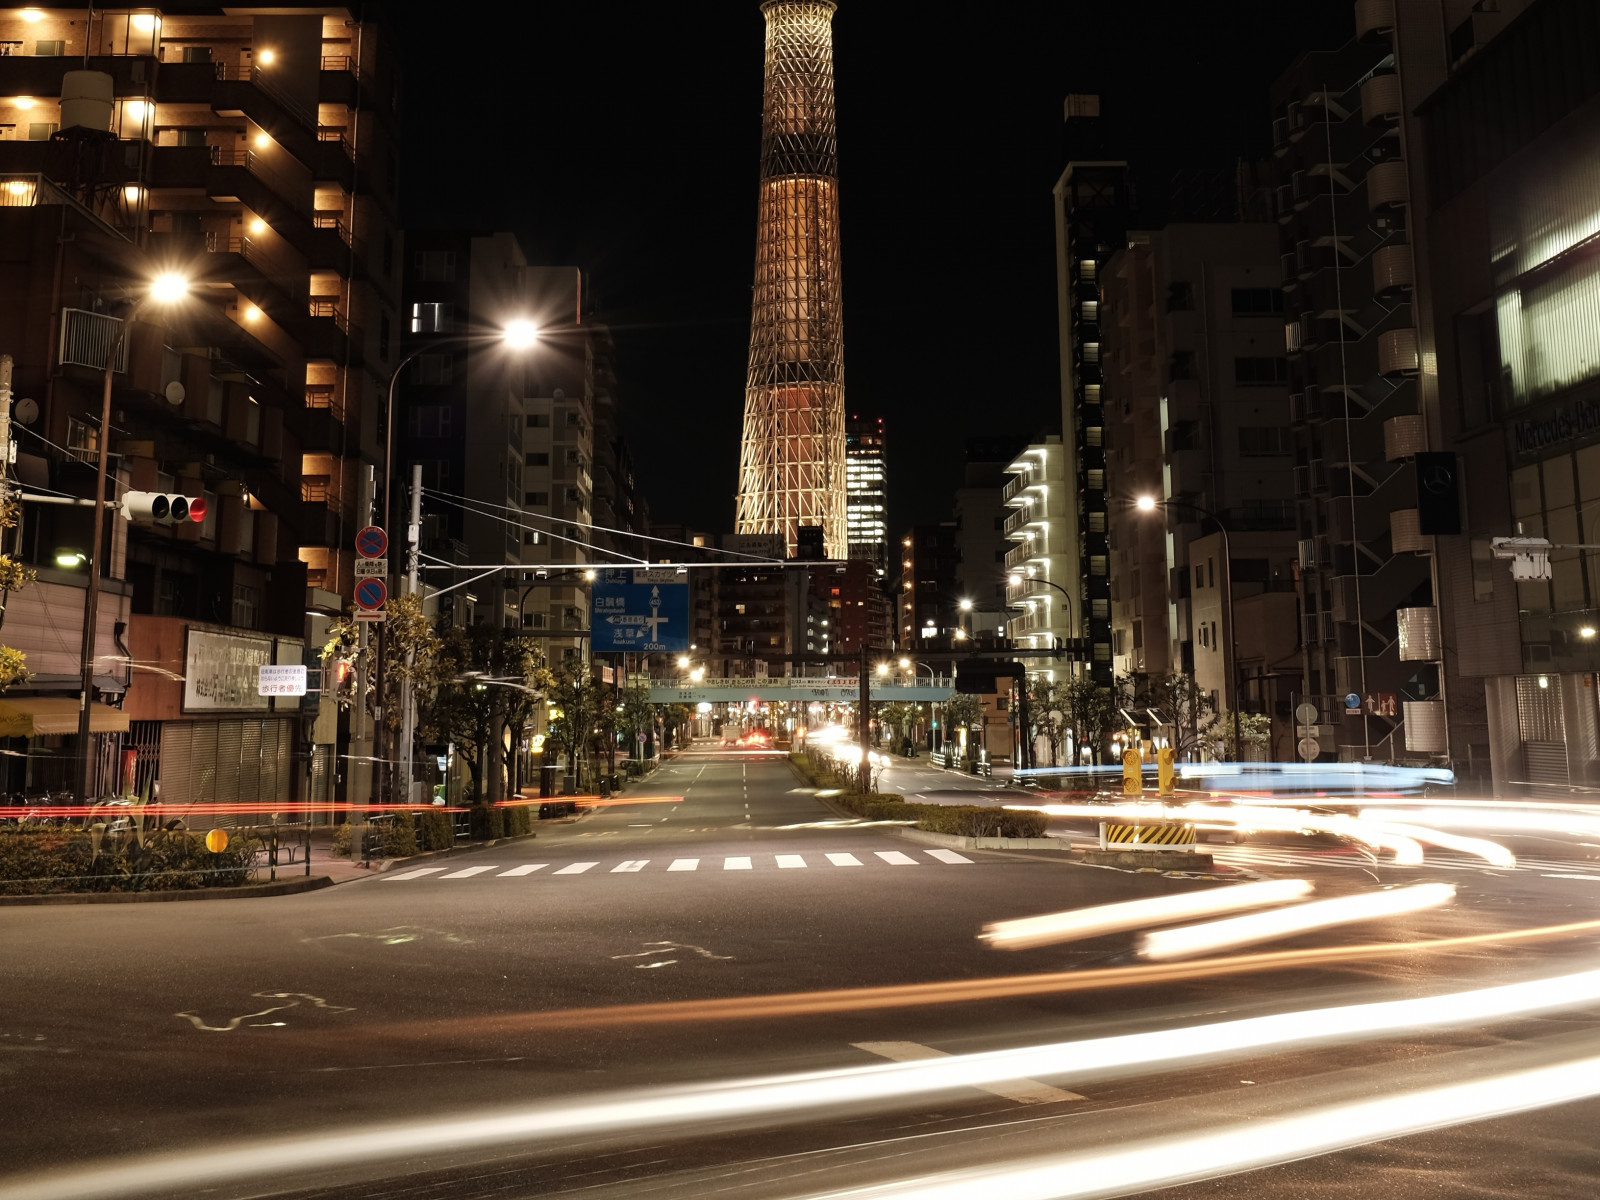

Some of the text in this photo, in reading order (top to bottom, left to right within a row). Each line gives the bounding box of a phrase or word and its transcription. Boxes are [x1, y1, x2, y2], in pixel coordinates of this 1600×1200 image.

[606, 569, 627, 578] 押上
[613, 629, 635, 638] 浅草
[262, 684, 303, 693] 歩行者優先
